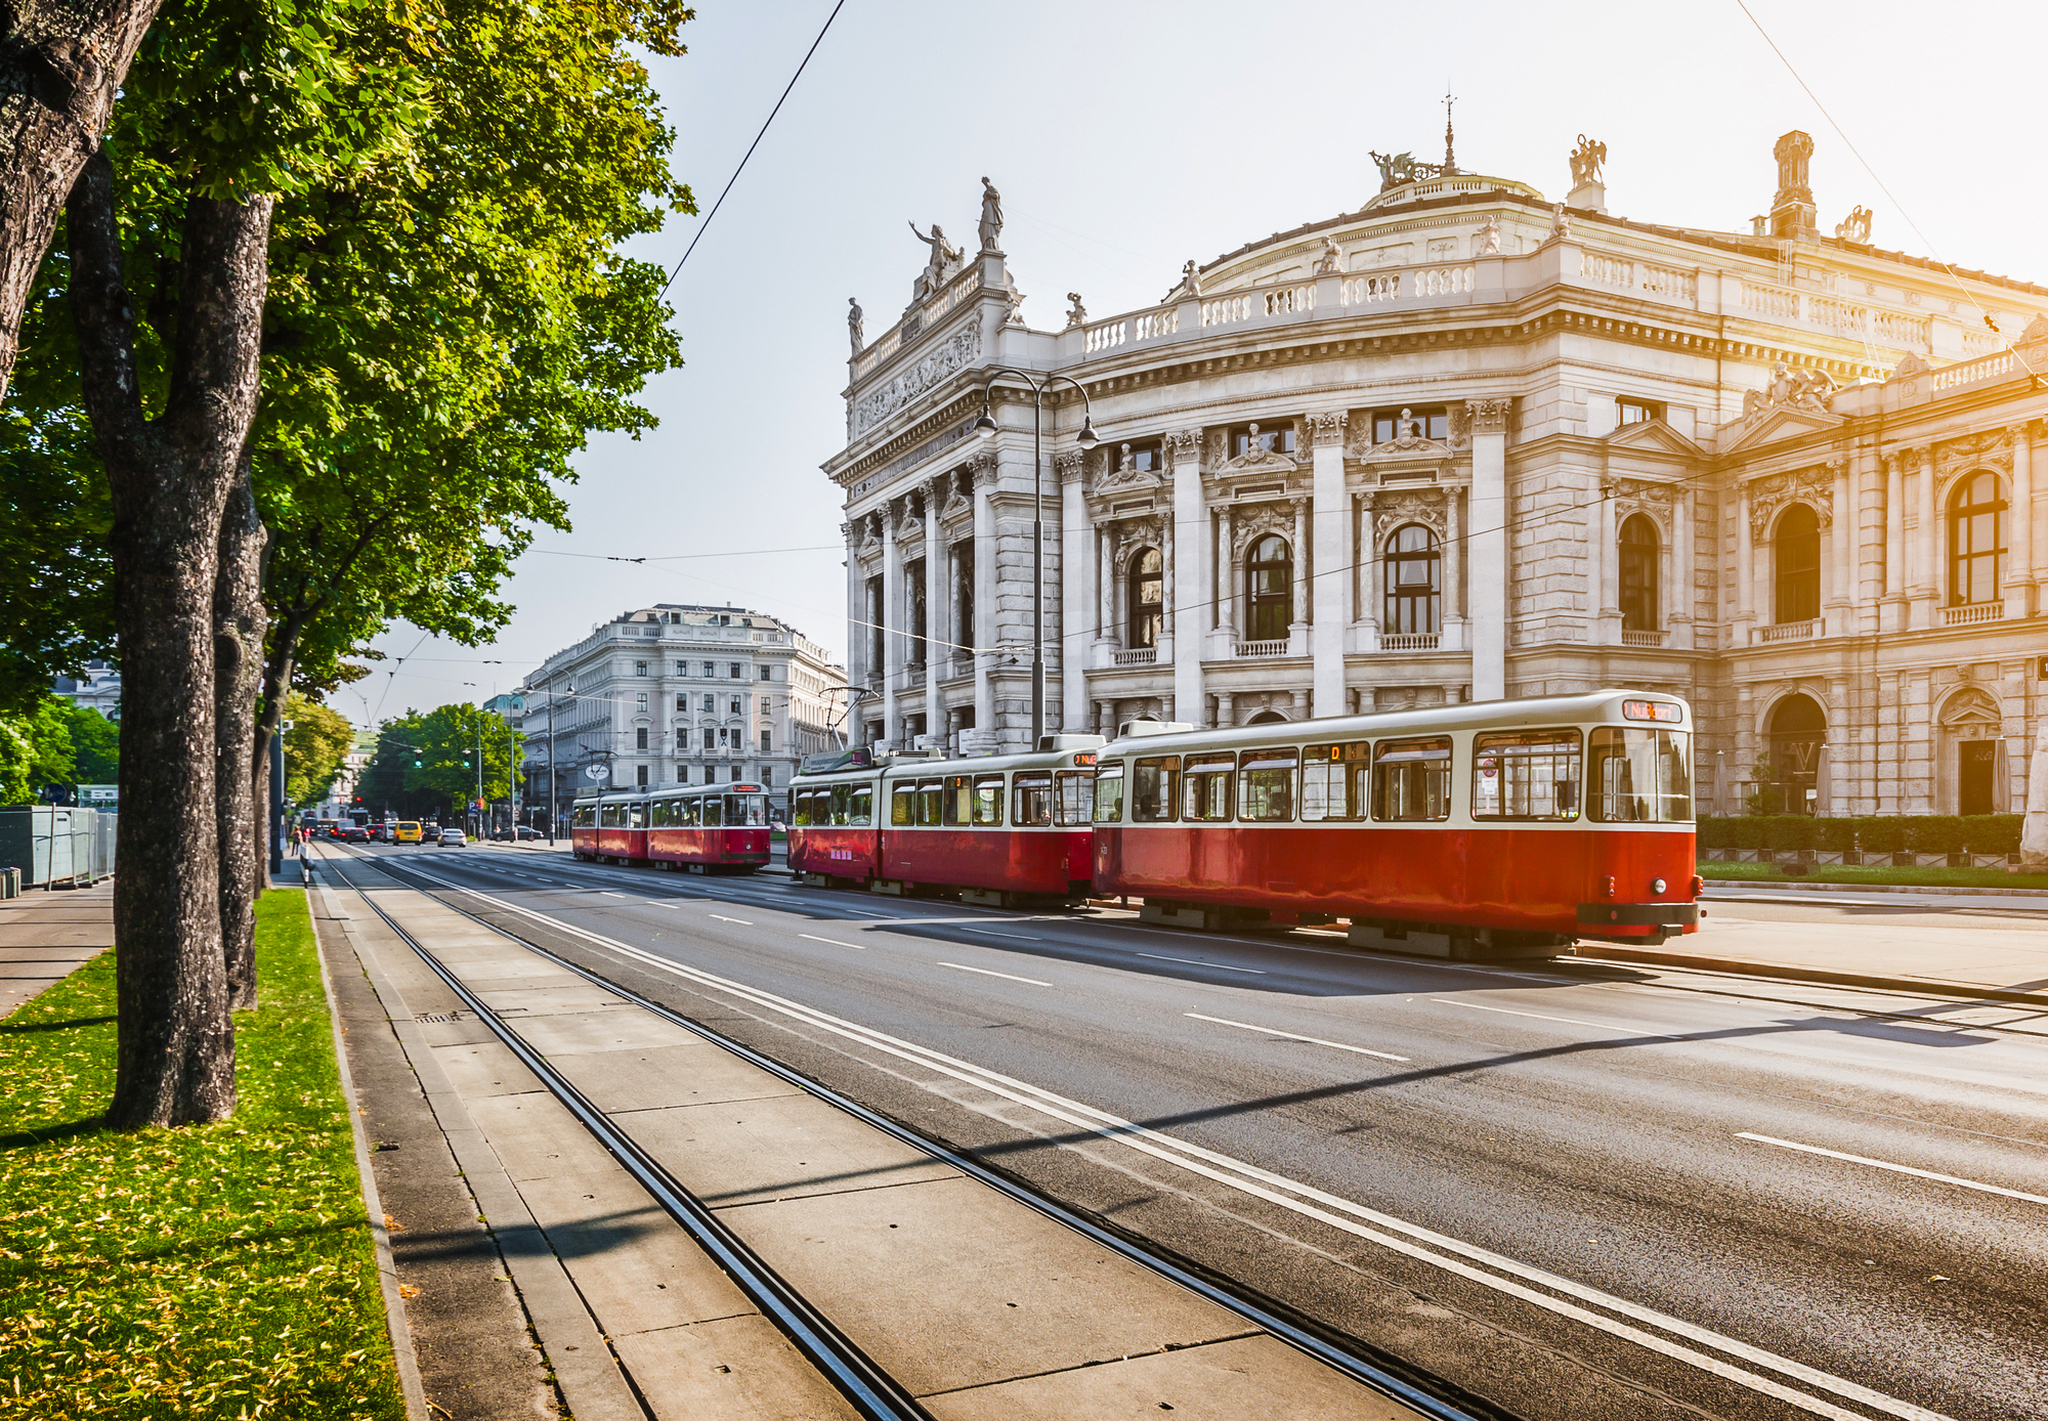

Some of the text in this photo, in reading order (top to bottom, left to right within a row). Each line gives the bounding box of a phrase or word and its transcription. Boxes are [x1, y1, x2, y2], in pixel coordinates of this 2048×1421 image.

[1631, 702, 1673, 719] Nußdorf
[1331, 746, 1340, 760] D
[470, 802, 476, 810] P
